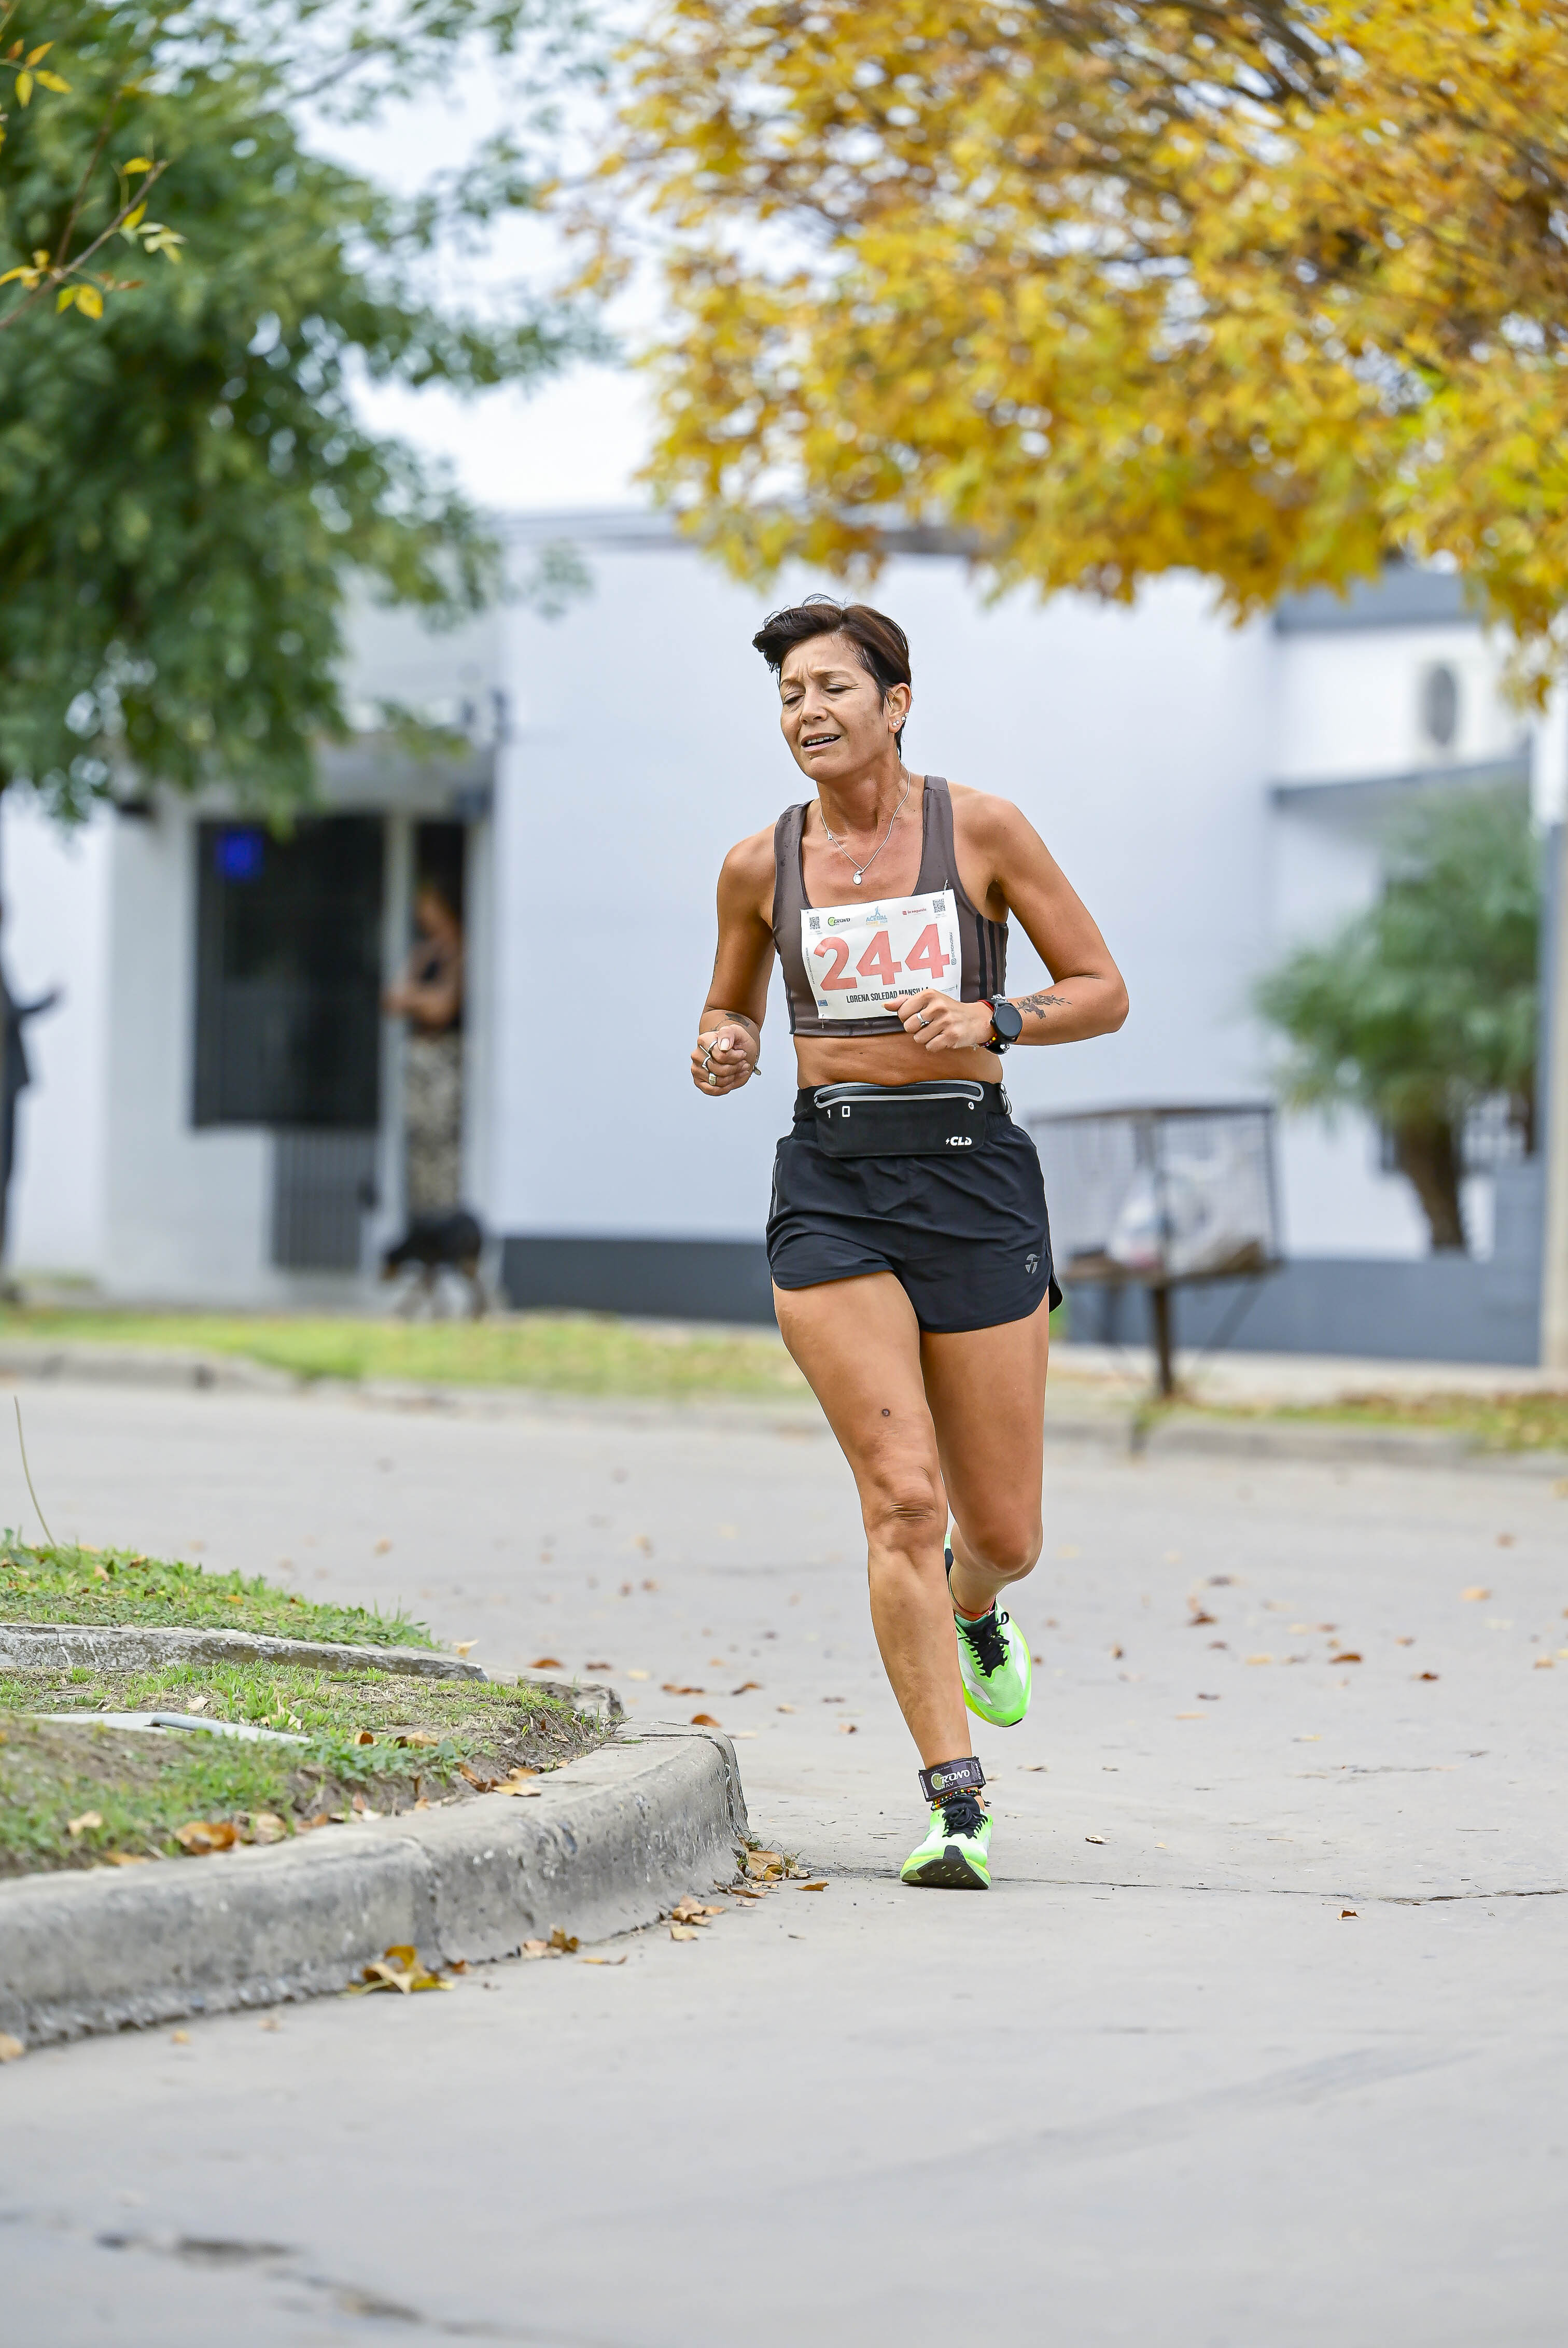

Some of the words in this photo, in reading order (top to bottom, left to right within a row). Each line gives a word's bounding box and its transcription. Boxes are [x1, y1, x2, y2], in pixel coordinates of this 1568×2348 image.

[813, 923, 950, 991] 244
[846, 994, 870, 1003] LORENA
[870, 990, 898, 1001] SOLEDAD
[899, 986, 929, 996] MANSI
